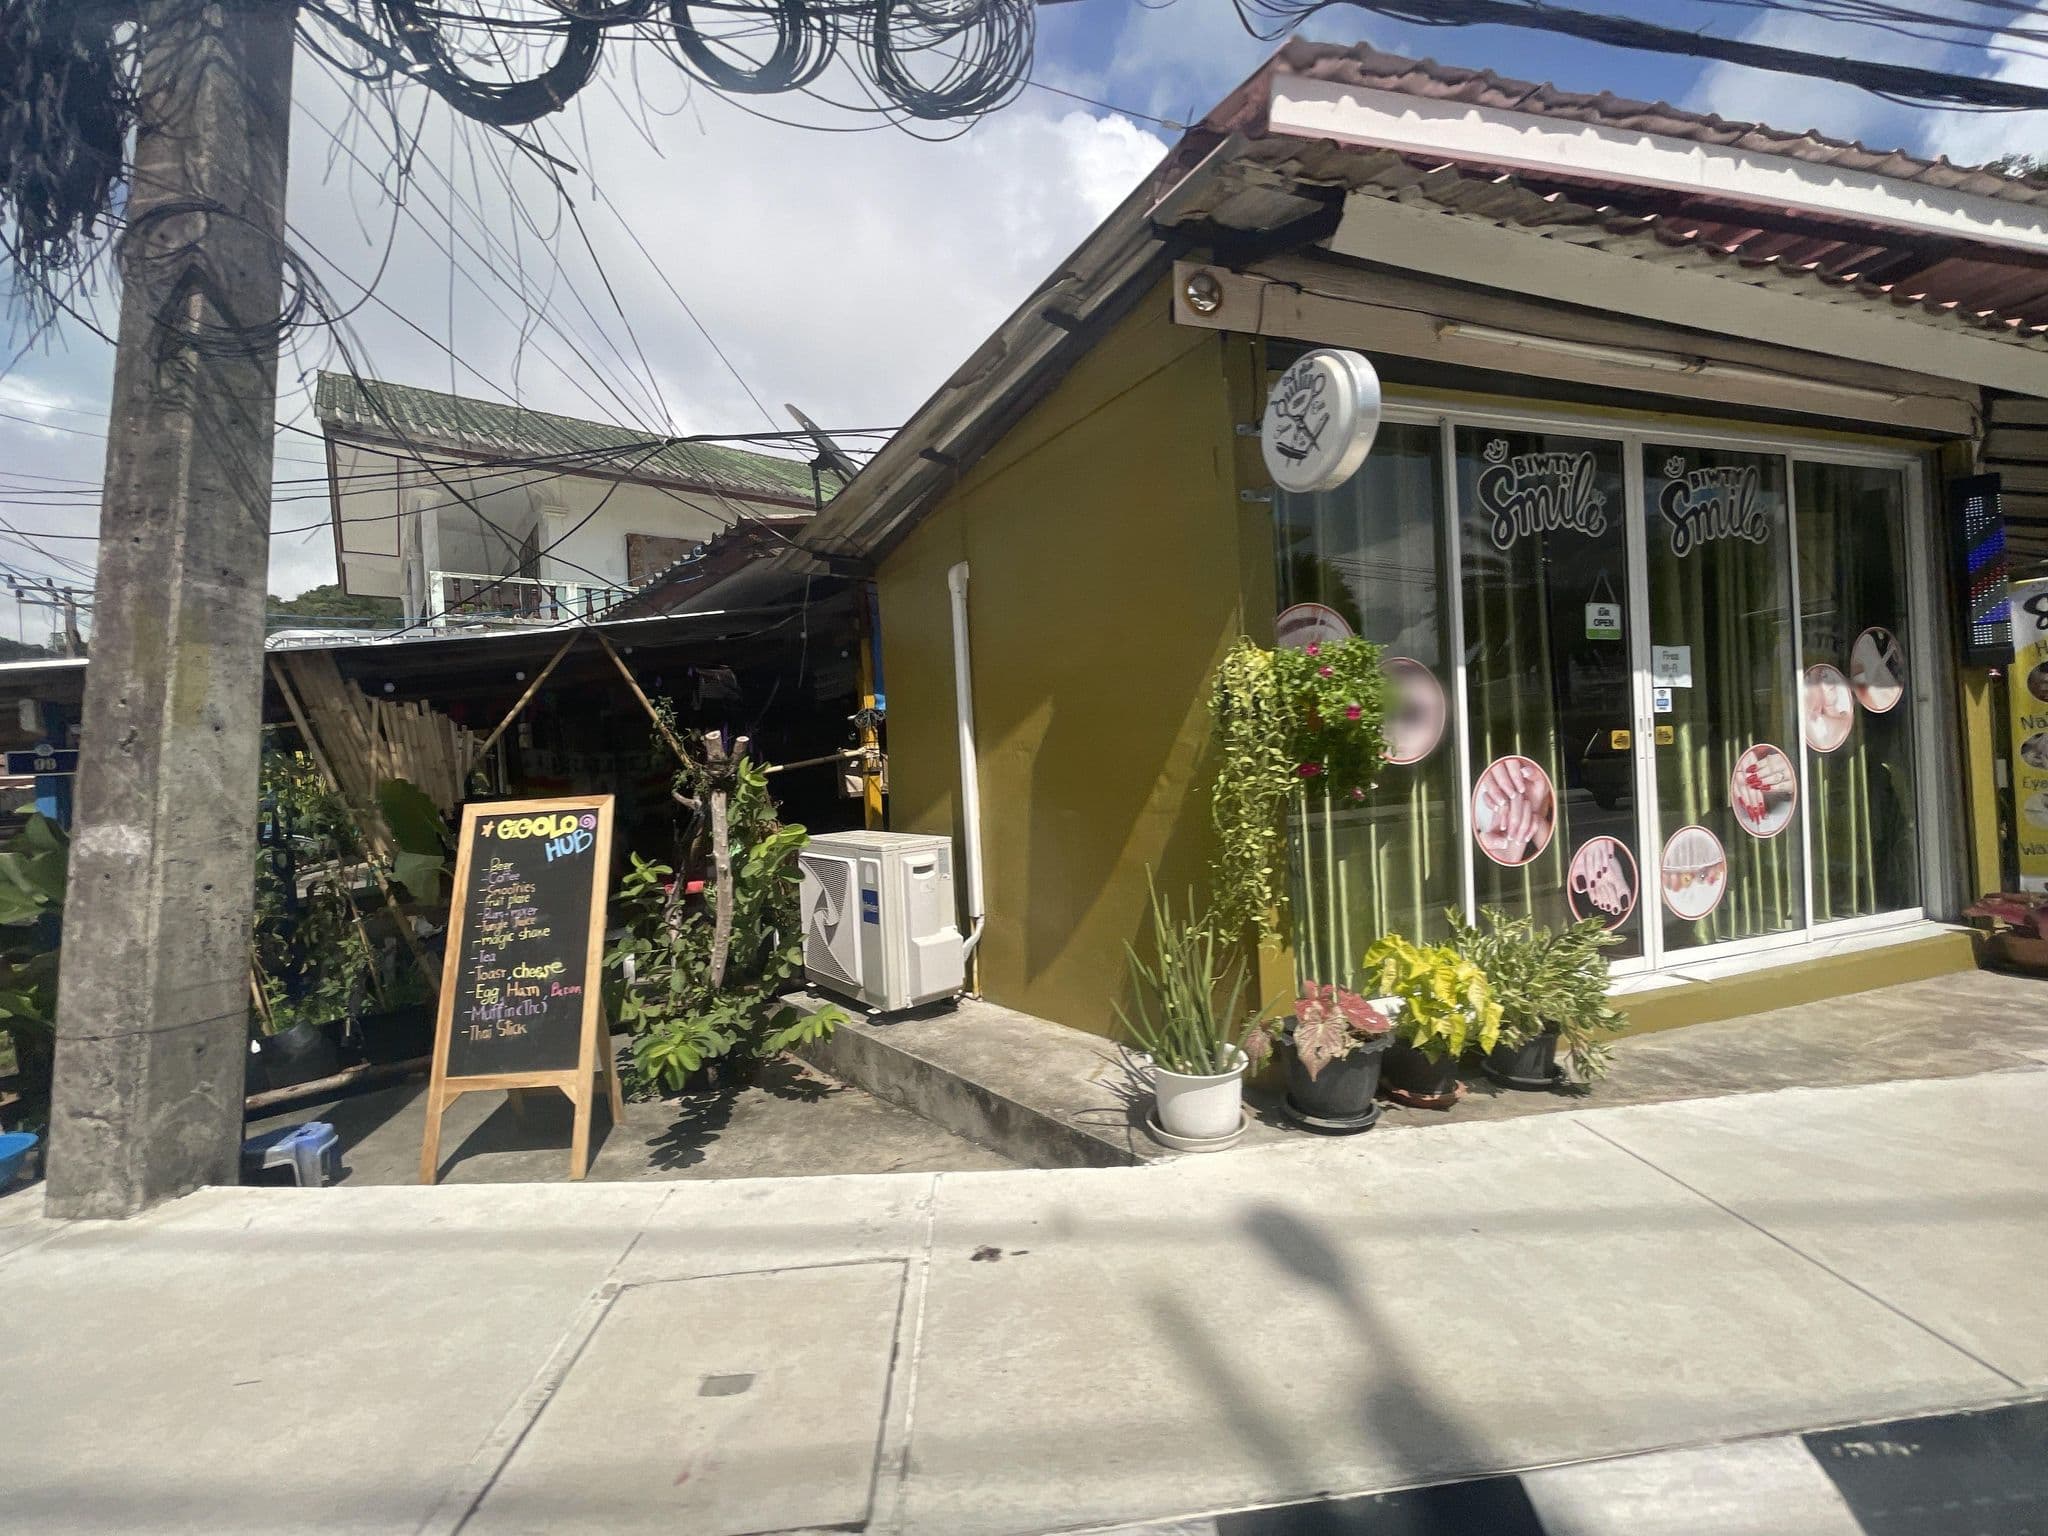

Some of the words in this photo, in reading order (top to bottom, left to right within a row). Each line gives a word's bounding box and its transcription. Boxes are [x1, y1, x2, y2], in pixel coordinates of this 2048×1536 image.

[1512, 452, 1578, 479] BIWTY
[1688, 467, 1744, 490] BIWTY
[1478, 451, 1606, 550] Smile
[1660, 465, 1768, 557] Smile
[1593, 618, 1614, 627] OPEN
[544, 829, 593, 862] HUB
[479, 949, 497, 963] Tea
[512, 961, 567, 979] cheese
[470, 1024, 494, 1041] Thai
